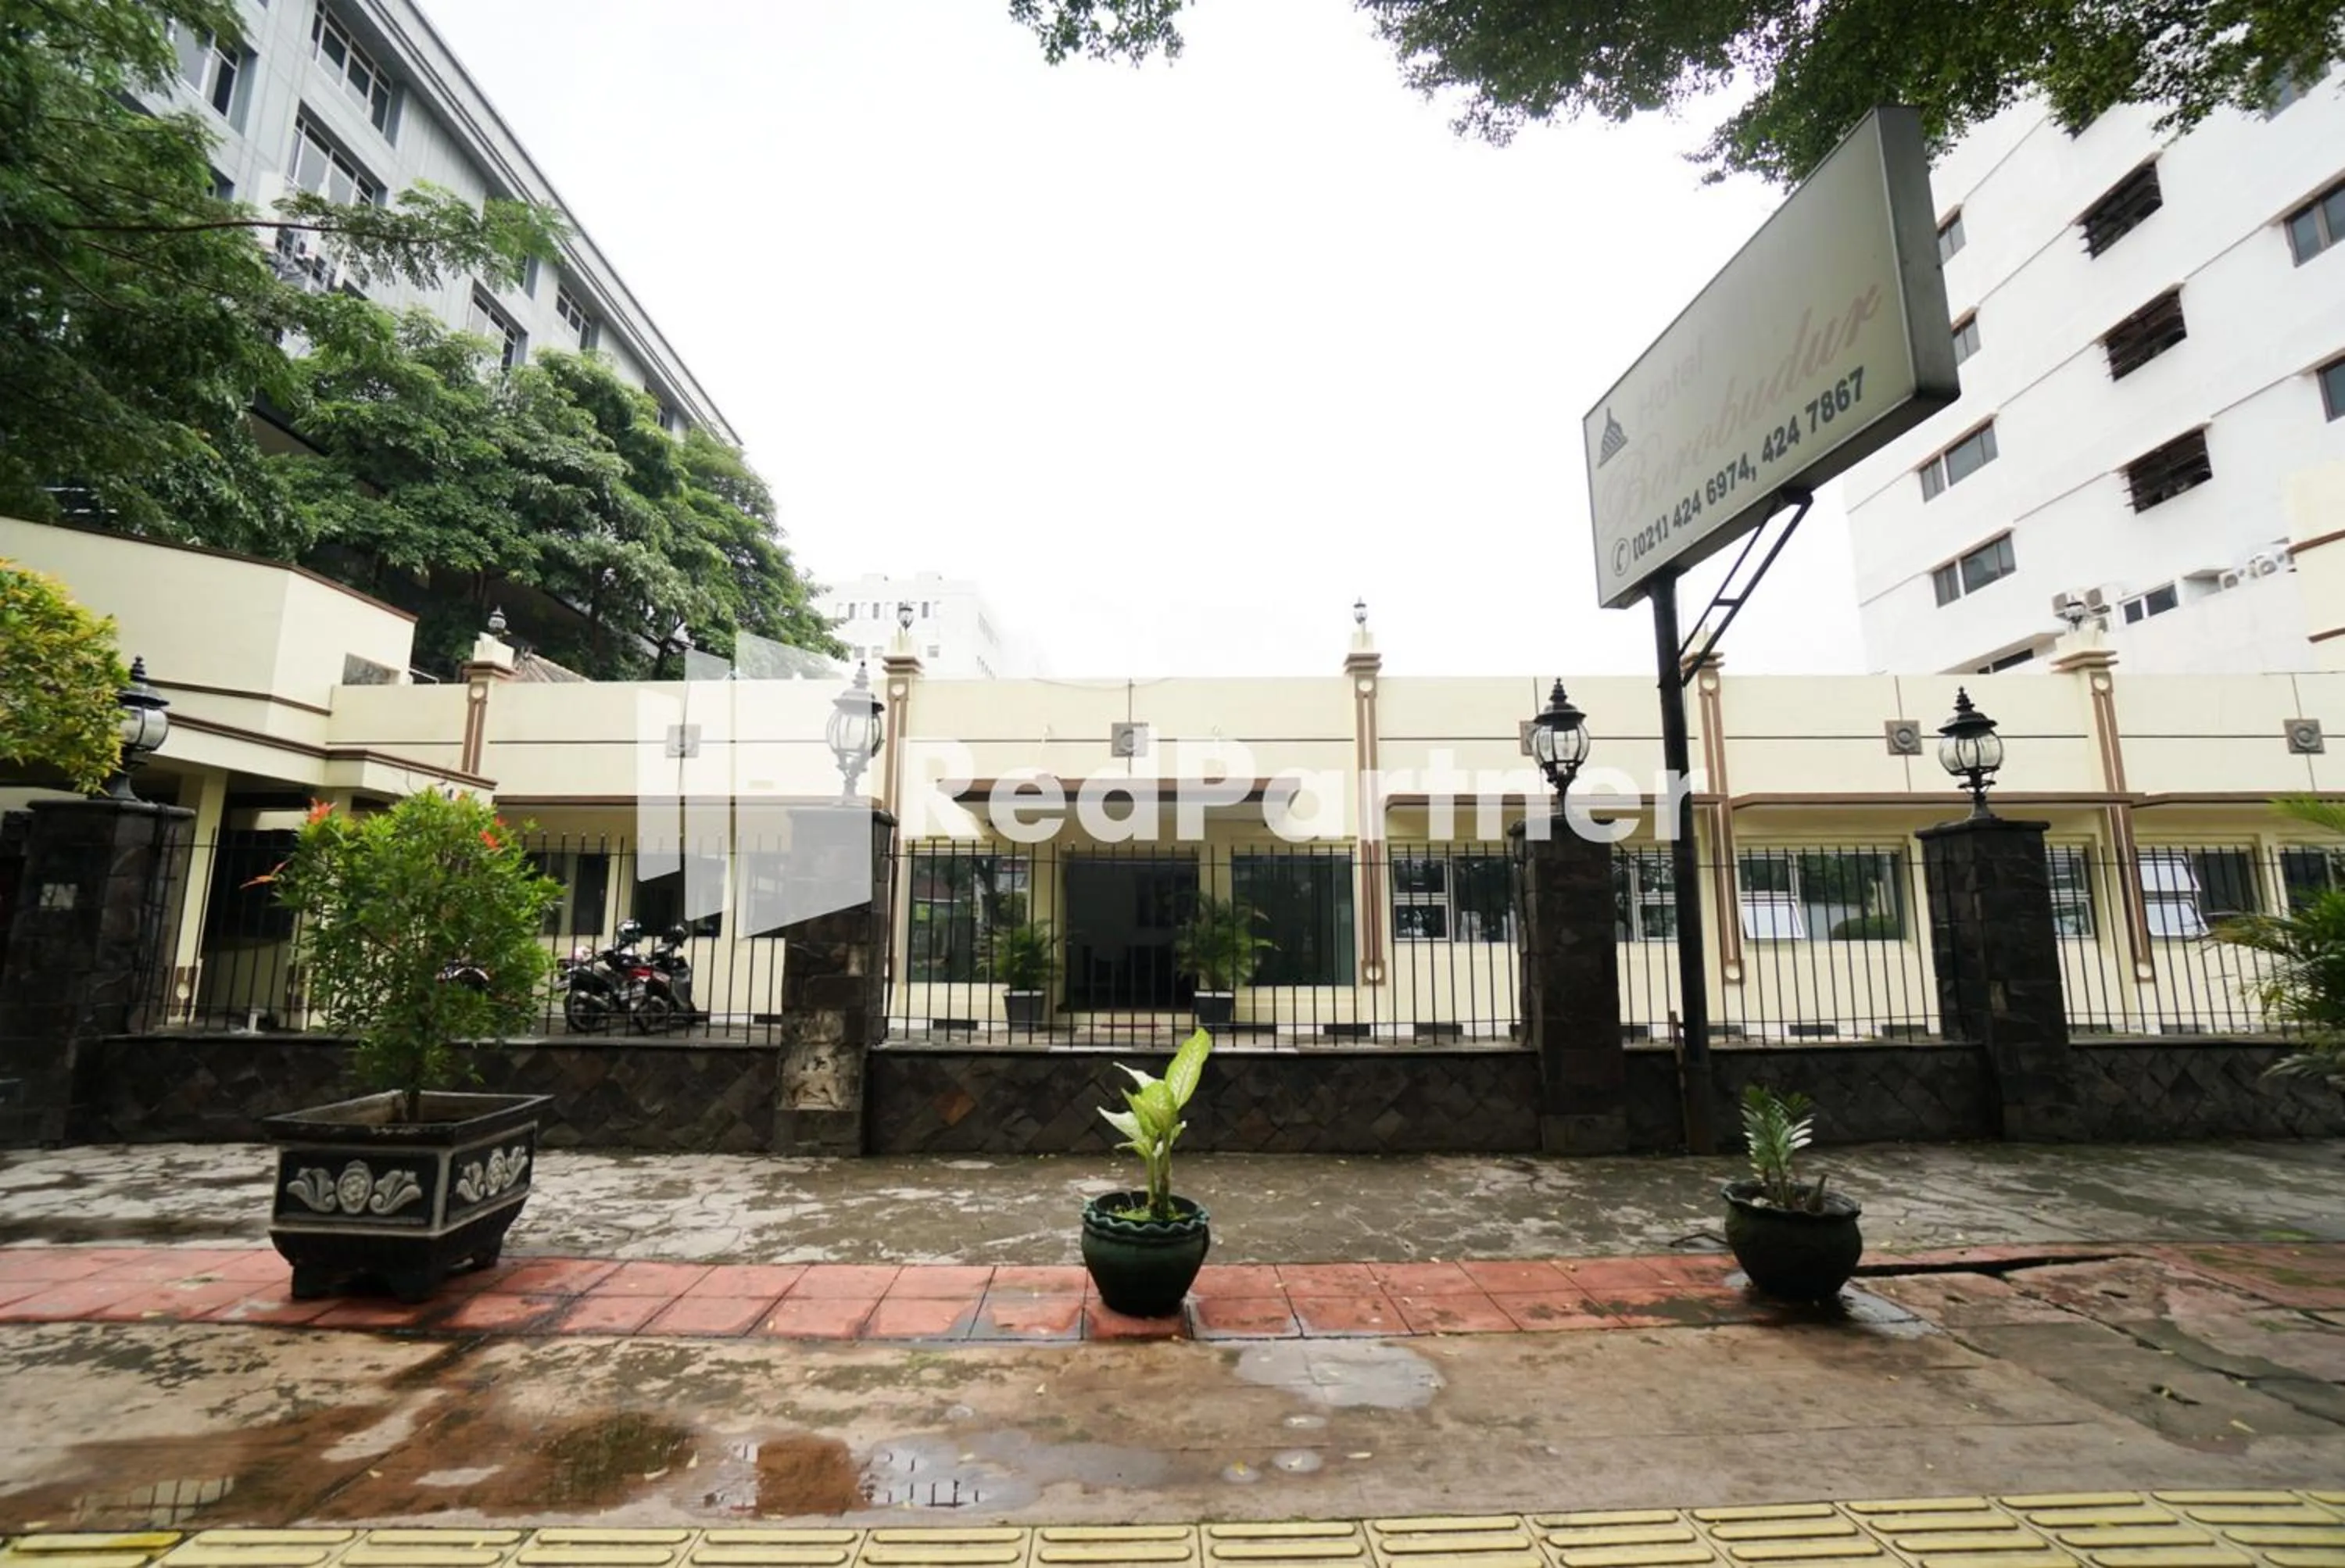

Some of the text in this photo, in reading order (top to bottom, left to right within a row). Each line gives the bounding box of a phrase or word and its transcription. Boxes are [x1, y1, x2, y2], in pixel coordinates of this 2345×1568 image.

[1599, 282, 1883, 536] Borobudur
[1672, 489, 1702, 528] 424
[1706, 452, 1756, 507] 6974,
[1762, 414, 1801, 463] 424
[1805, 365, 1863, 435] 7867
